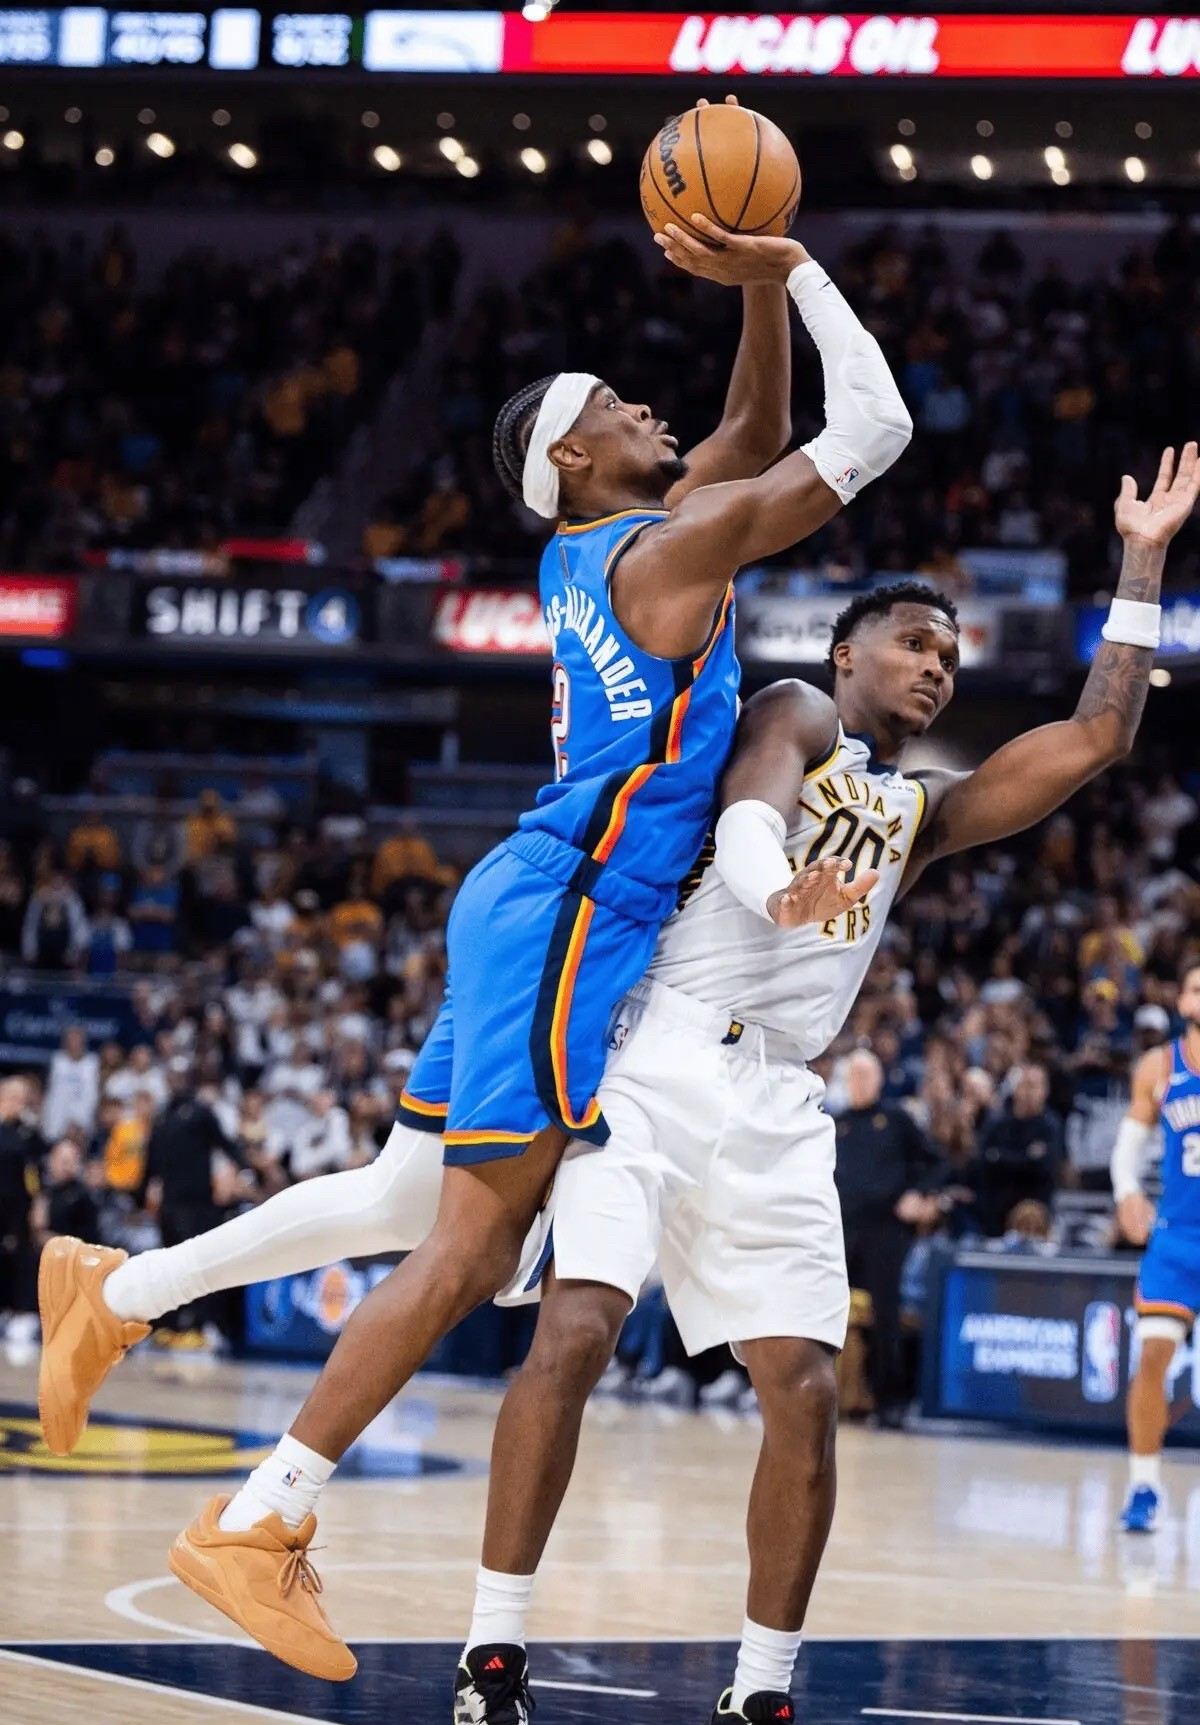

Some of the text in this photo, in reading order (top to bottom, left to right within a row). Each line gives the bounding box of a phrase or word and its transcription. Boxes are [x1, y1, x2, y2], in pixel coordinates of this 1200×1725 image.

[669, 15, 940, 74] LUCAS OIL
[1120, 17, 1200, 76] LU
[147, 586, 307, 637] SHIFT
[799, 773, 902, 864] INDIANA
[804, 806, 886, 904] 00
